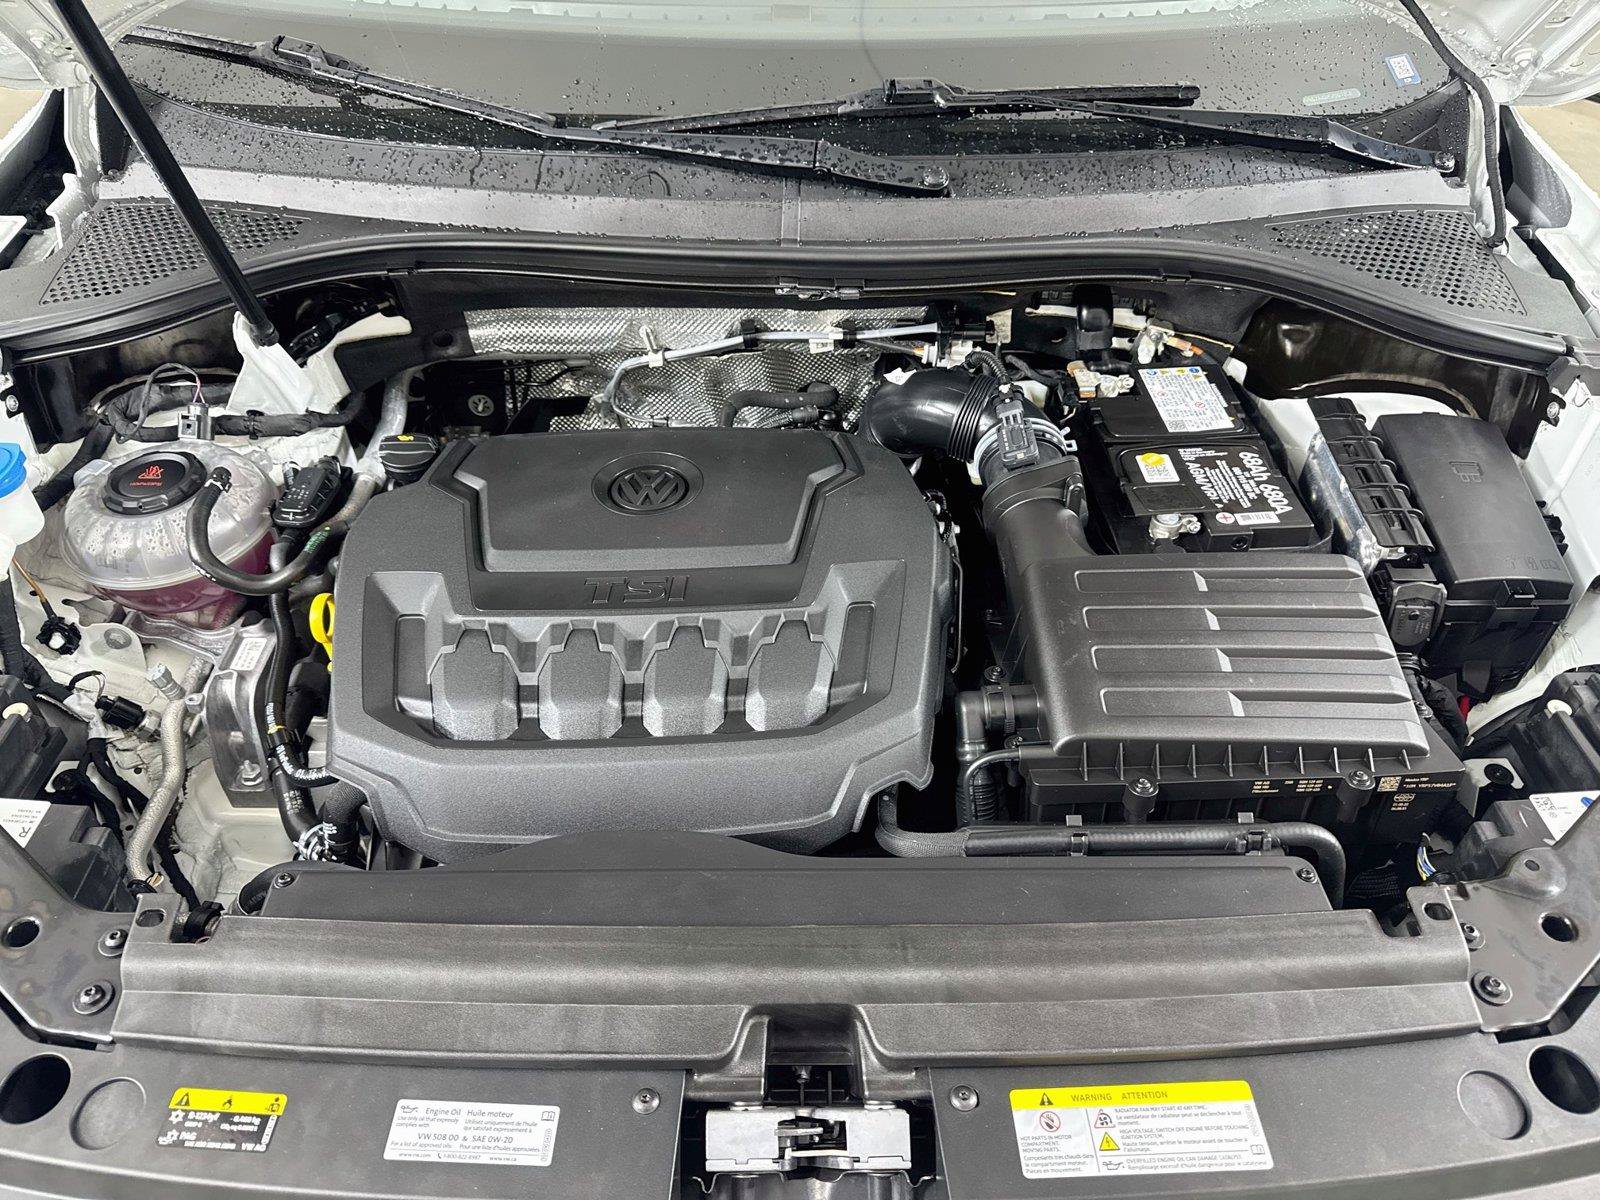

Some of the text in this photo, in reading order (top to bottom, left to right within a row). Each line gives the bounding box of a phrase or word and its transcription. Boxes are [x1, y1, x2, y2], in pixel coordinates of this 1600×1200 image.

[611, 467, 687, 510] VW
[1238, 451, 1272, 481] 68Ah
[1259, 483, 1294, 515] 680A
[584, 574, 690, 604] TSI
[18, 826, 31, 838] R
[1070, 1091, 1168, 1102] WARNING ATTENTION
[425, 1107, 450, 1116] Engine
[467, 1109, 514, 1118] Huile moteur
[418, 1132, 432, 1140] VW
